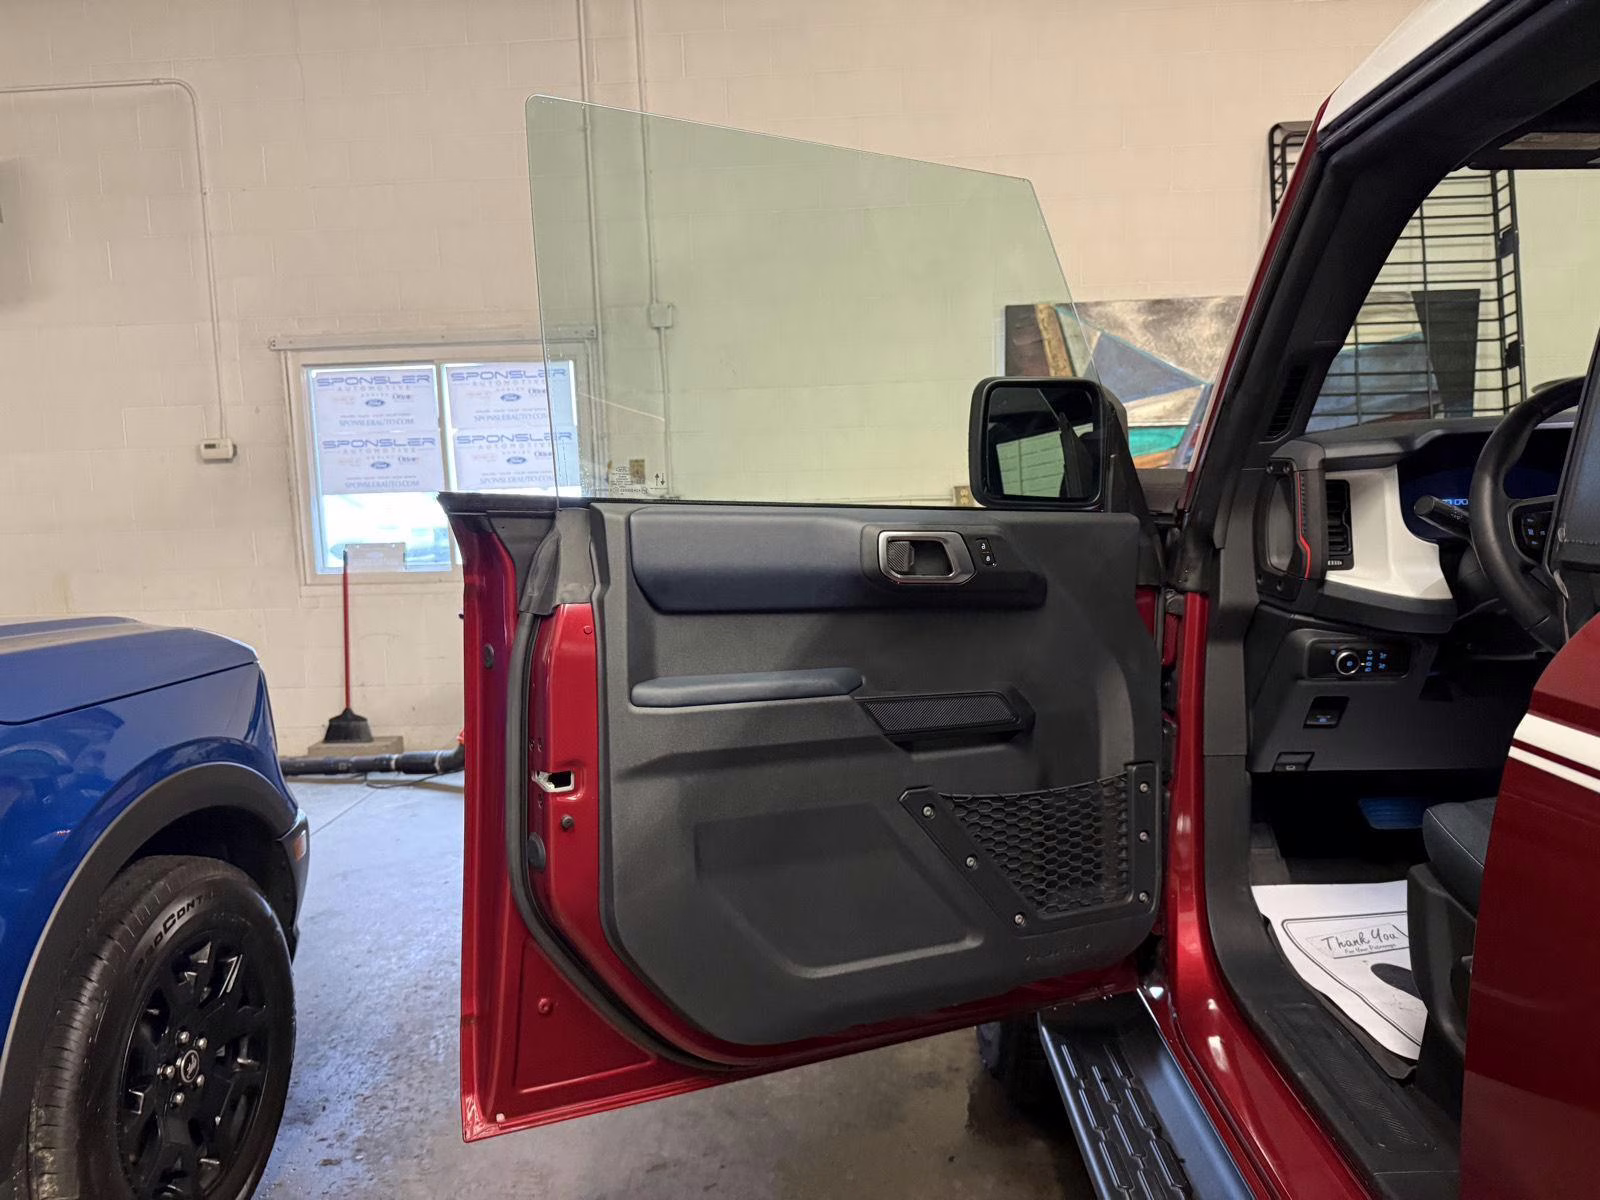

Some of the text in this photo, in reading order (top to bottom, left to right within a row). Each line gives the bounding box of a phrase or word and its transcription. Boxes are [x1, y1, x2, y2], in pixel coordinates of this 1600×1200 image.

[316, 374, 431, 387] SPONSLER
[451, 368, 567, 382] SPONSLER
[322, 437, 437, 450] SPONSLER
[456, 431, 573, 445] SPONSLER
[1320, 927, 1398, 951] Thank You
